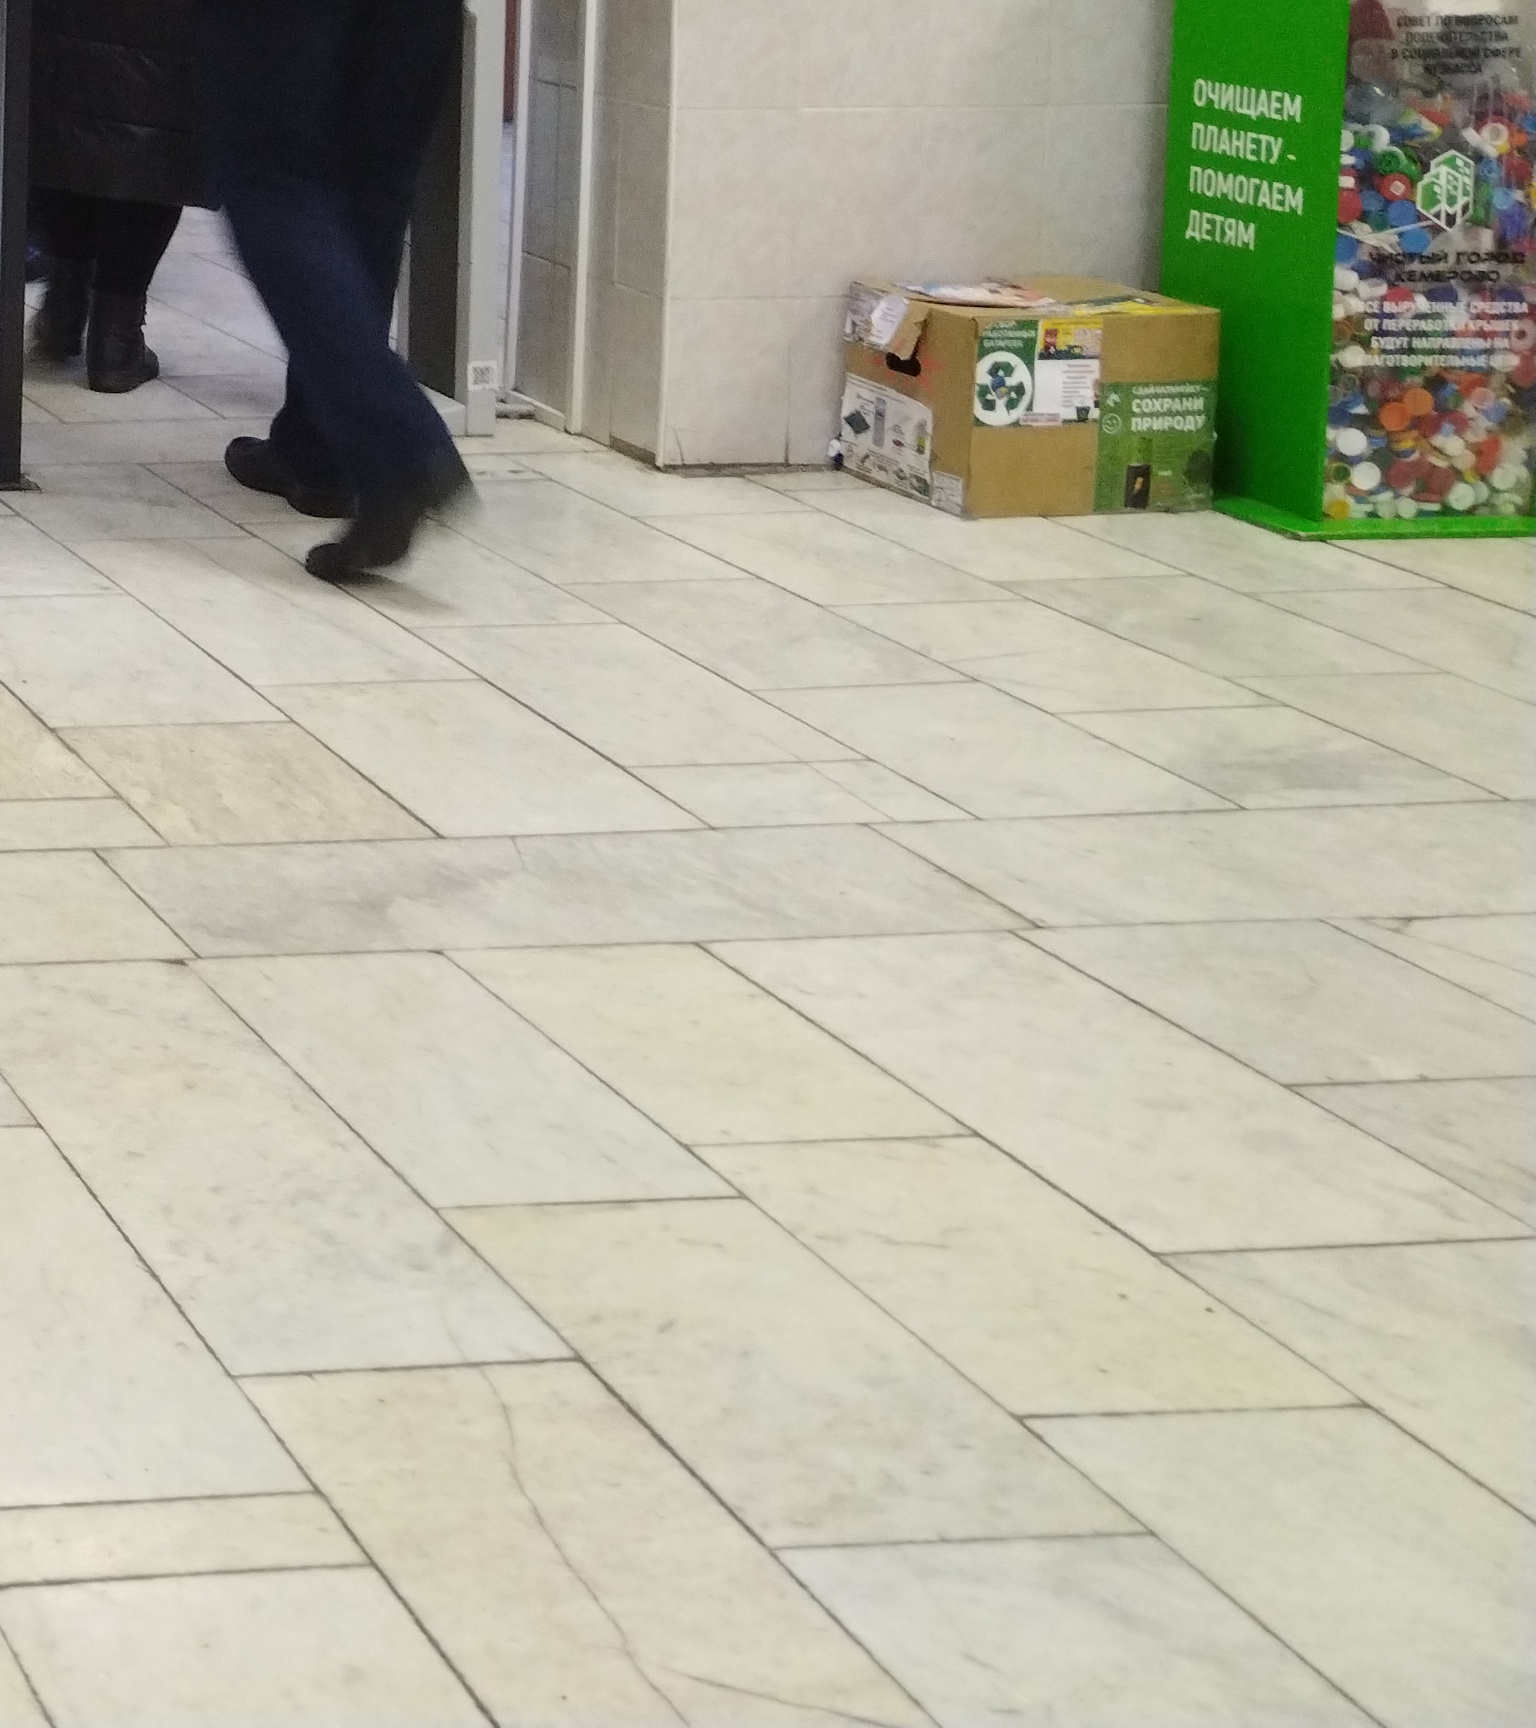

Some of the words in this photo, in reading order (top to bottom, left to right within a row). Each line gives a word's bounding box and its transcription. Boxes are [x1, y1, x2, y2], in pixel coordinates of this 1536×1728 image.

[1193, 78, 1302, 123] ОЧИЩАЕМ
[1191, 122, 1283, 165] ПЛАНЕТУ
[1189, 165, 1304, 216] ПОМОГАЕМ
[1185, 209, 1256, 251] ДЕТЯМ
[1130, 414, 1206, 432] ПРИРОДУ
[1131, 396, 1205, 414] СОХРАНИ
